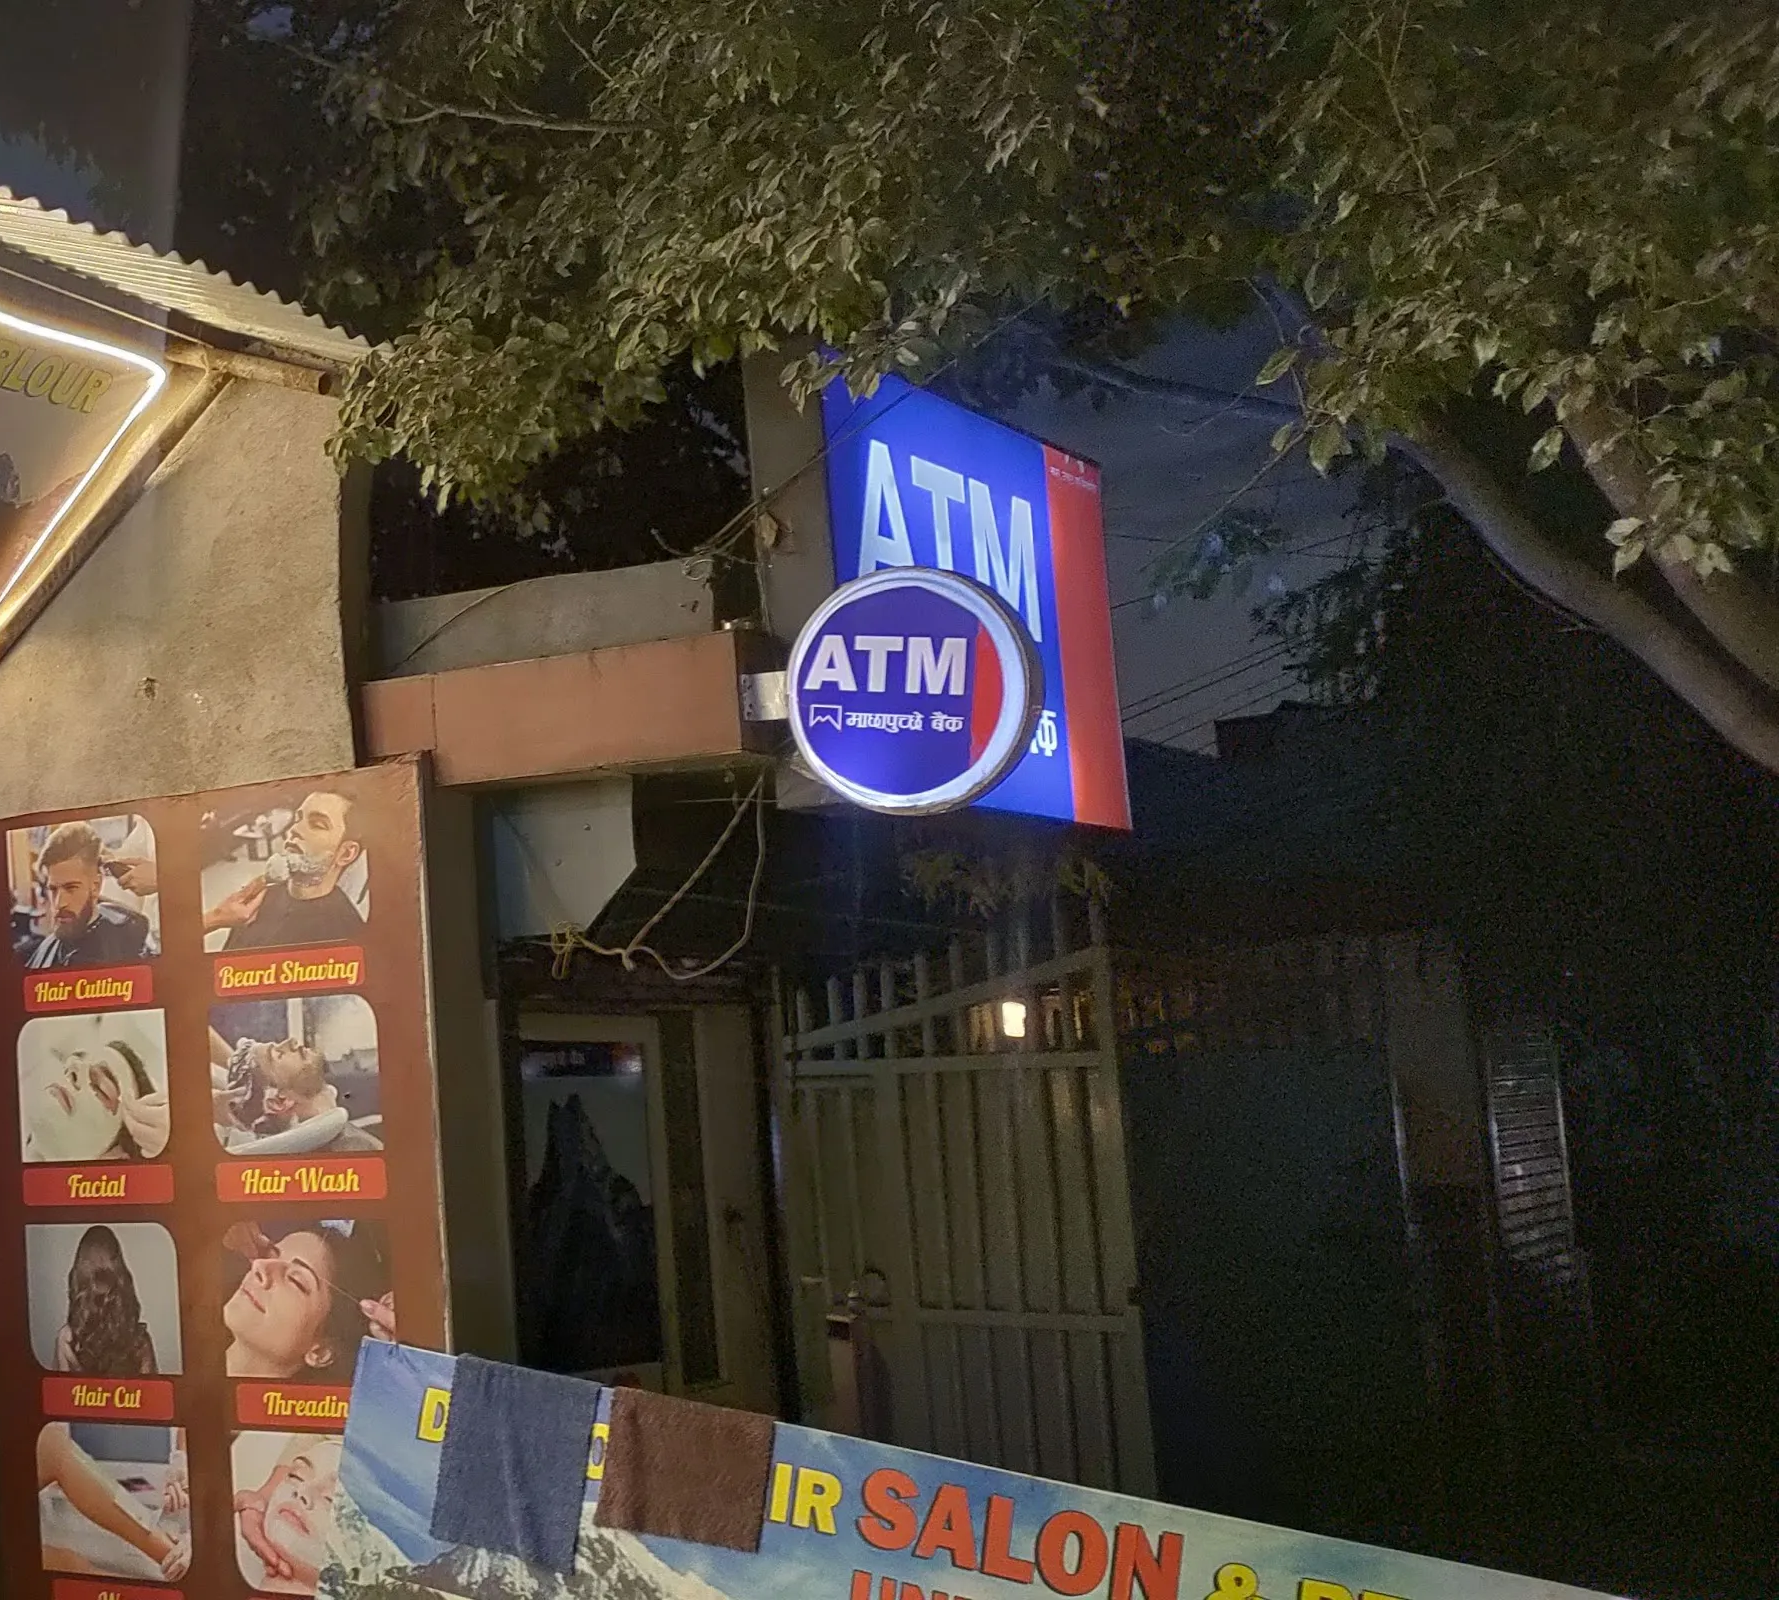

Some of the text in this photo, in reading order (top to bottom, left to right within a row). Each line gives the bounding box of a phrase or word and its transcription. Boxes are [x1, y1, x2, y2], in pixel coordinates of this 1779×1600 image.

[858, 439, 1043, 643] ATM
[803, 634, 968, 696] ATM
[929, 711, 965, 732] बैंक
[219, 958, 359, 989] Beard Shaving
[34, 977, 134, 1003] Hair Cutting
[67, 1172, 127, 1199] Facial
[241, 1166, 360, 1195] Hair Wash
[71, 1384, 143, 1409] Hair Cut
[263, 1391, 349, 1419] Threadin
[855, 1467, 1186, 1600] SALON
